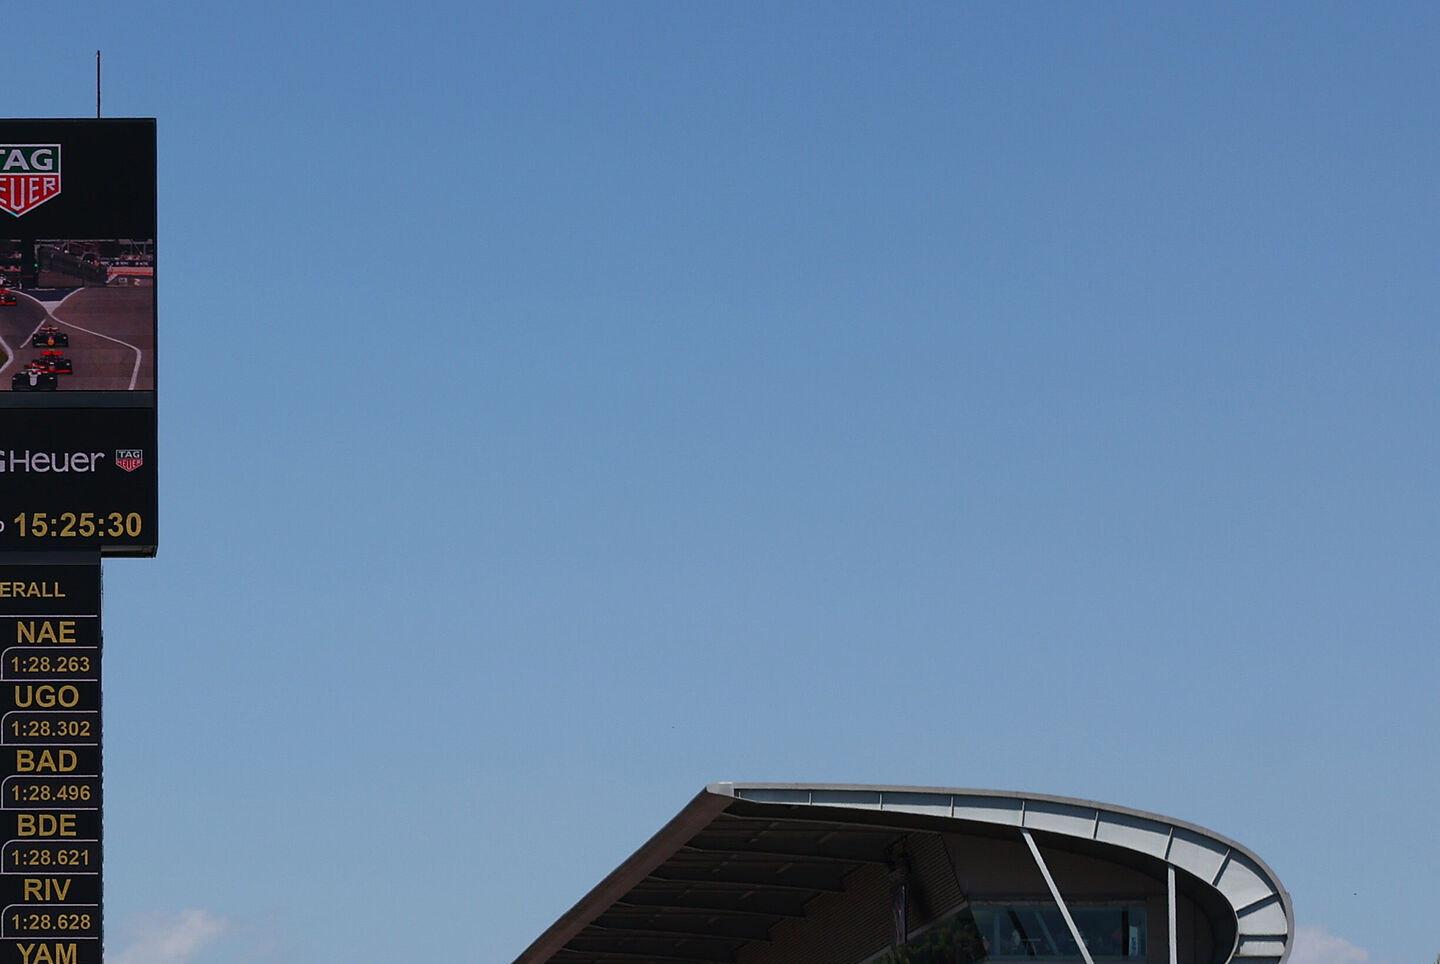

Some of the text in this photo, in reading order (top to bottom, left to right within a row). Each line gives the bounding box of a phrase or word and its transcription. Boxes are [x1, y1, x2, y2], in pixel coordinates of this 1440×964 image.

[118, 450, 141, 459] TAG
[117, 459, 142, 471] HEUER
[13, 512, 143, 537] 15:25:30
[17, 621, 76, 643] NAE
[11, 656, 90, 673] 1:28.263
[15, 685, 79, 708] UGO
[11, 720, 91, 737] 1:28.302
[16, 749, 78, 772] BAD
[11, 784, 91, 801] 1:28.496
[17, 814, 77, 837] BDE
[11, 849, 89, 866] 1:28.621
[24, 878, 72, 901] RIV
[12, 914, 91, 930] 1:28.628
